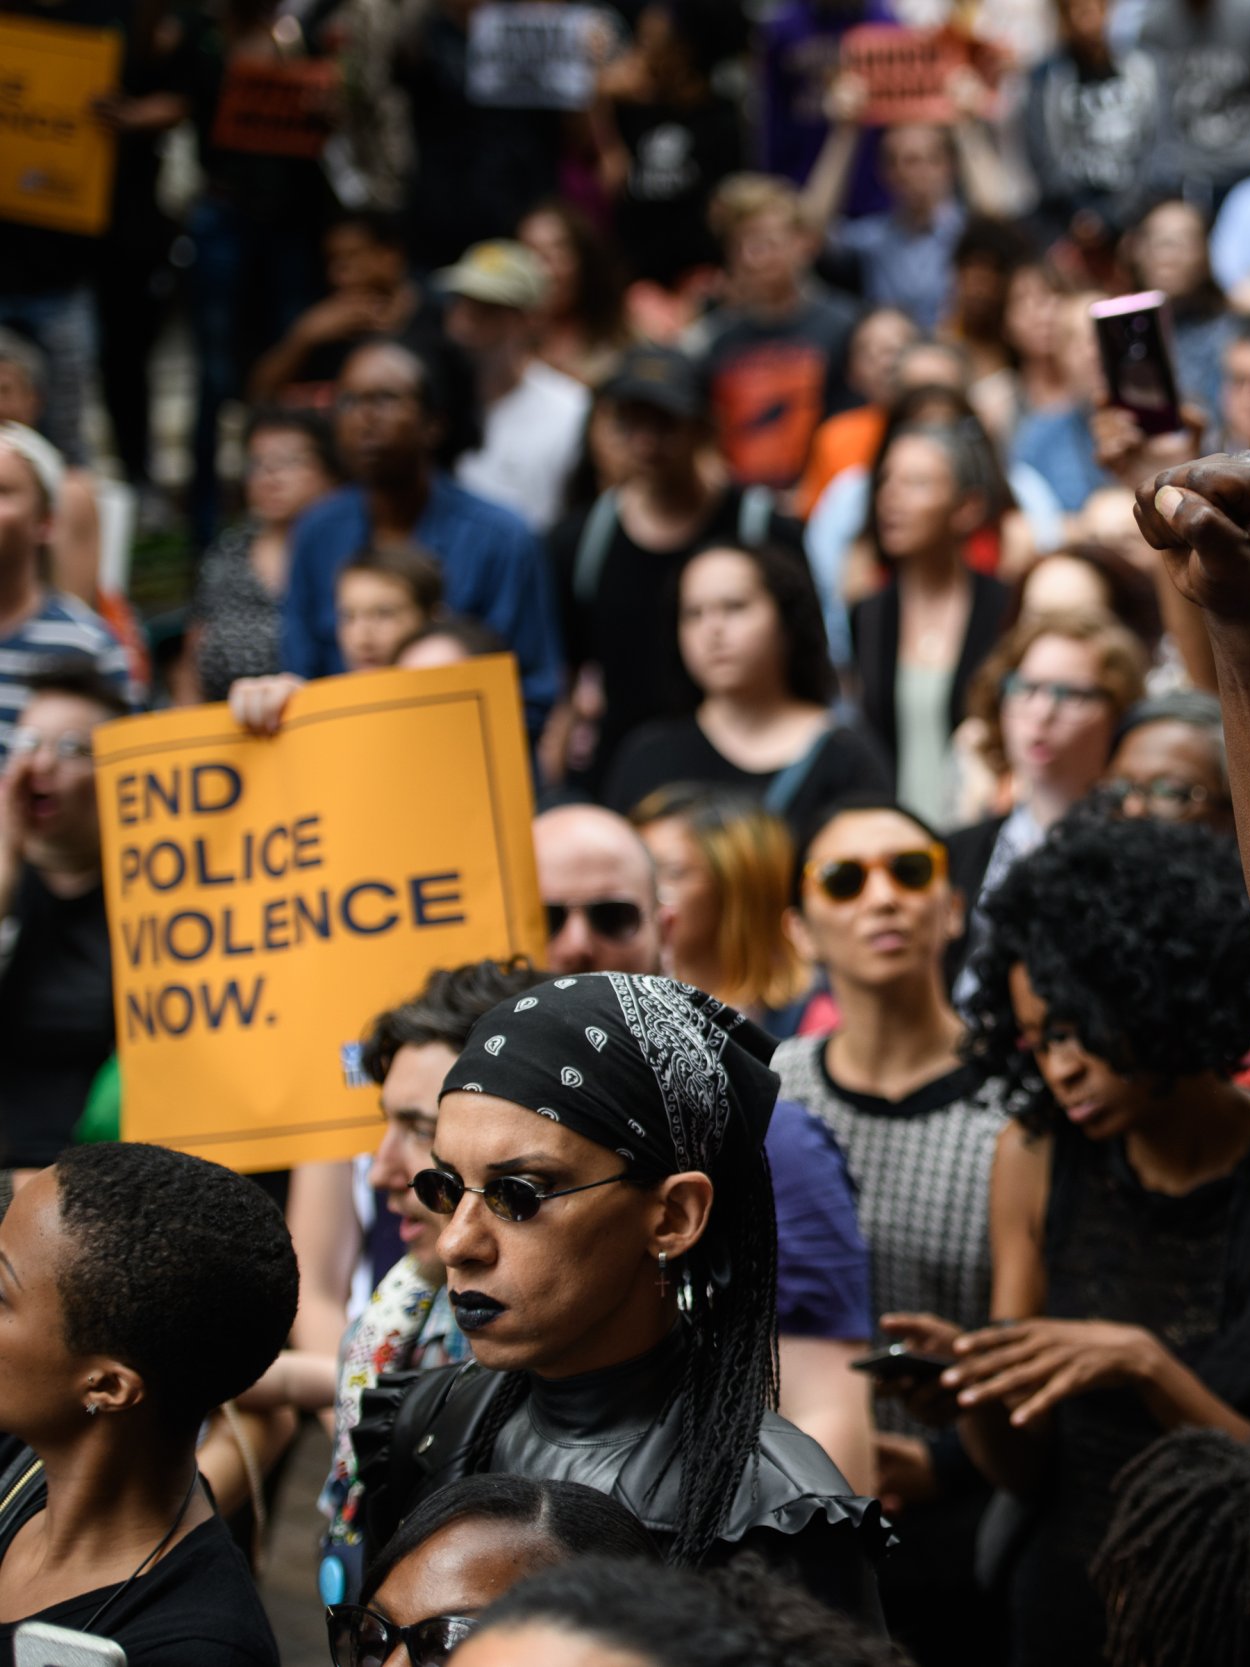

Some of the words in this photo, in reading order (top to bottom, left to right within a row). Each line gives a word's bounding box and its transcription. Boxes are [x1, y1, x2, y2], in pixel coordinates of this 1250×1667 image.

[116, 763, 243, 826] END
[121, 814, 325, 896] POLICE
[122, 871, 467, 968] VIOLENCE
[126, 976, 279, 1040] NOW.
